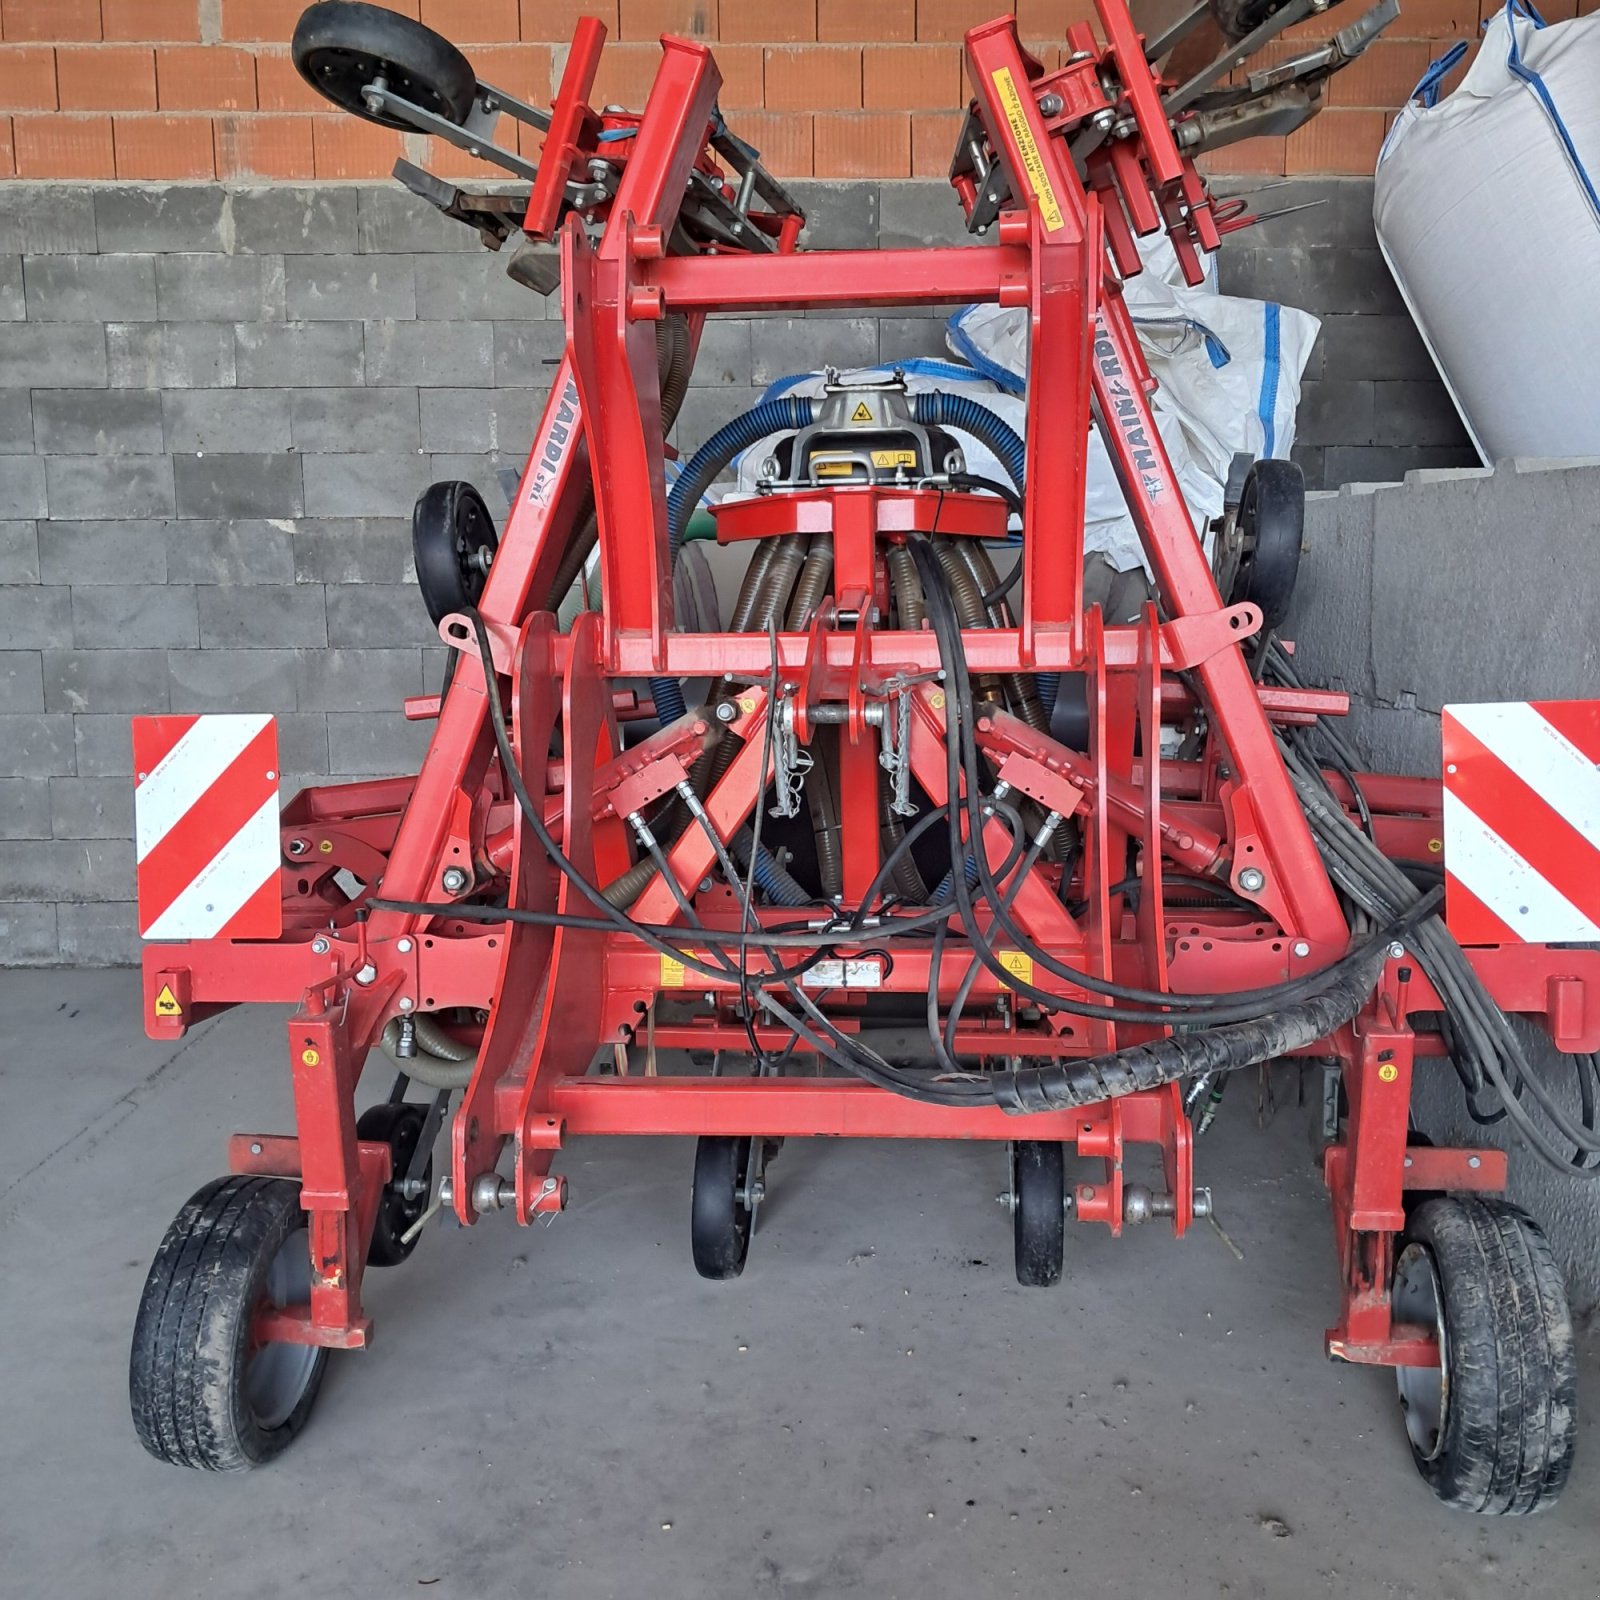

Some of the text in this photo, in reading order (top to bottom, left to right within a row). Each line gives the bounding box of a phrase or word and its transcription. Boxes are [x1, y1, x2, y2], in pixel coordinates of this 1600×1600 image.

[1016, 109, 1030, 138] RAGGIO
[1010, 117, 1034, 172] ATTENZIONE
[1027, 138, 1036, 152] NEL
[1032, 152, 1048, 187] SOSTARE
[1044, 188, 1054, 204] NON
[530, 373, 579, 501] NARDI SRL
